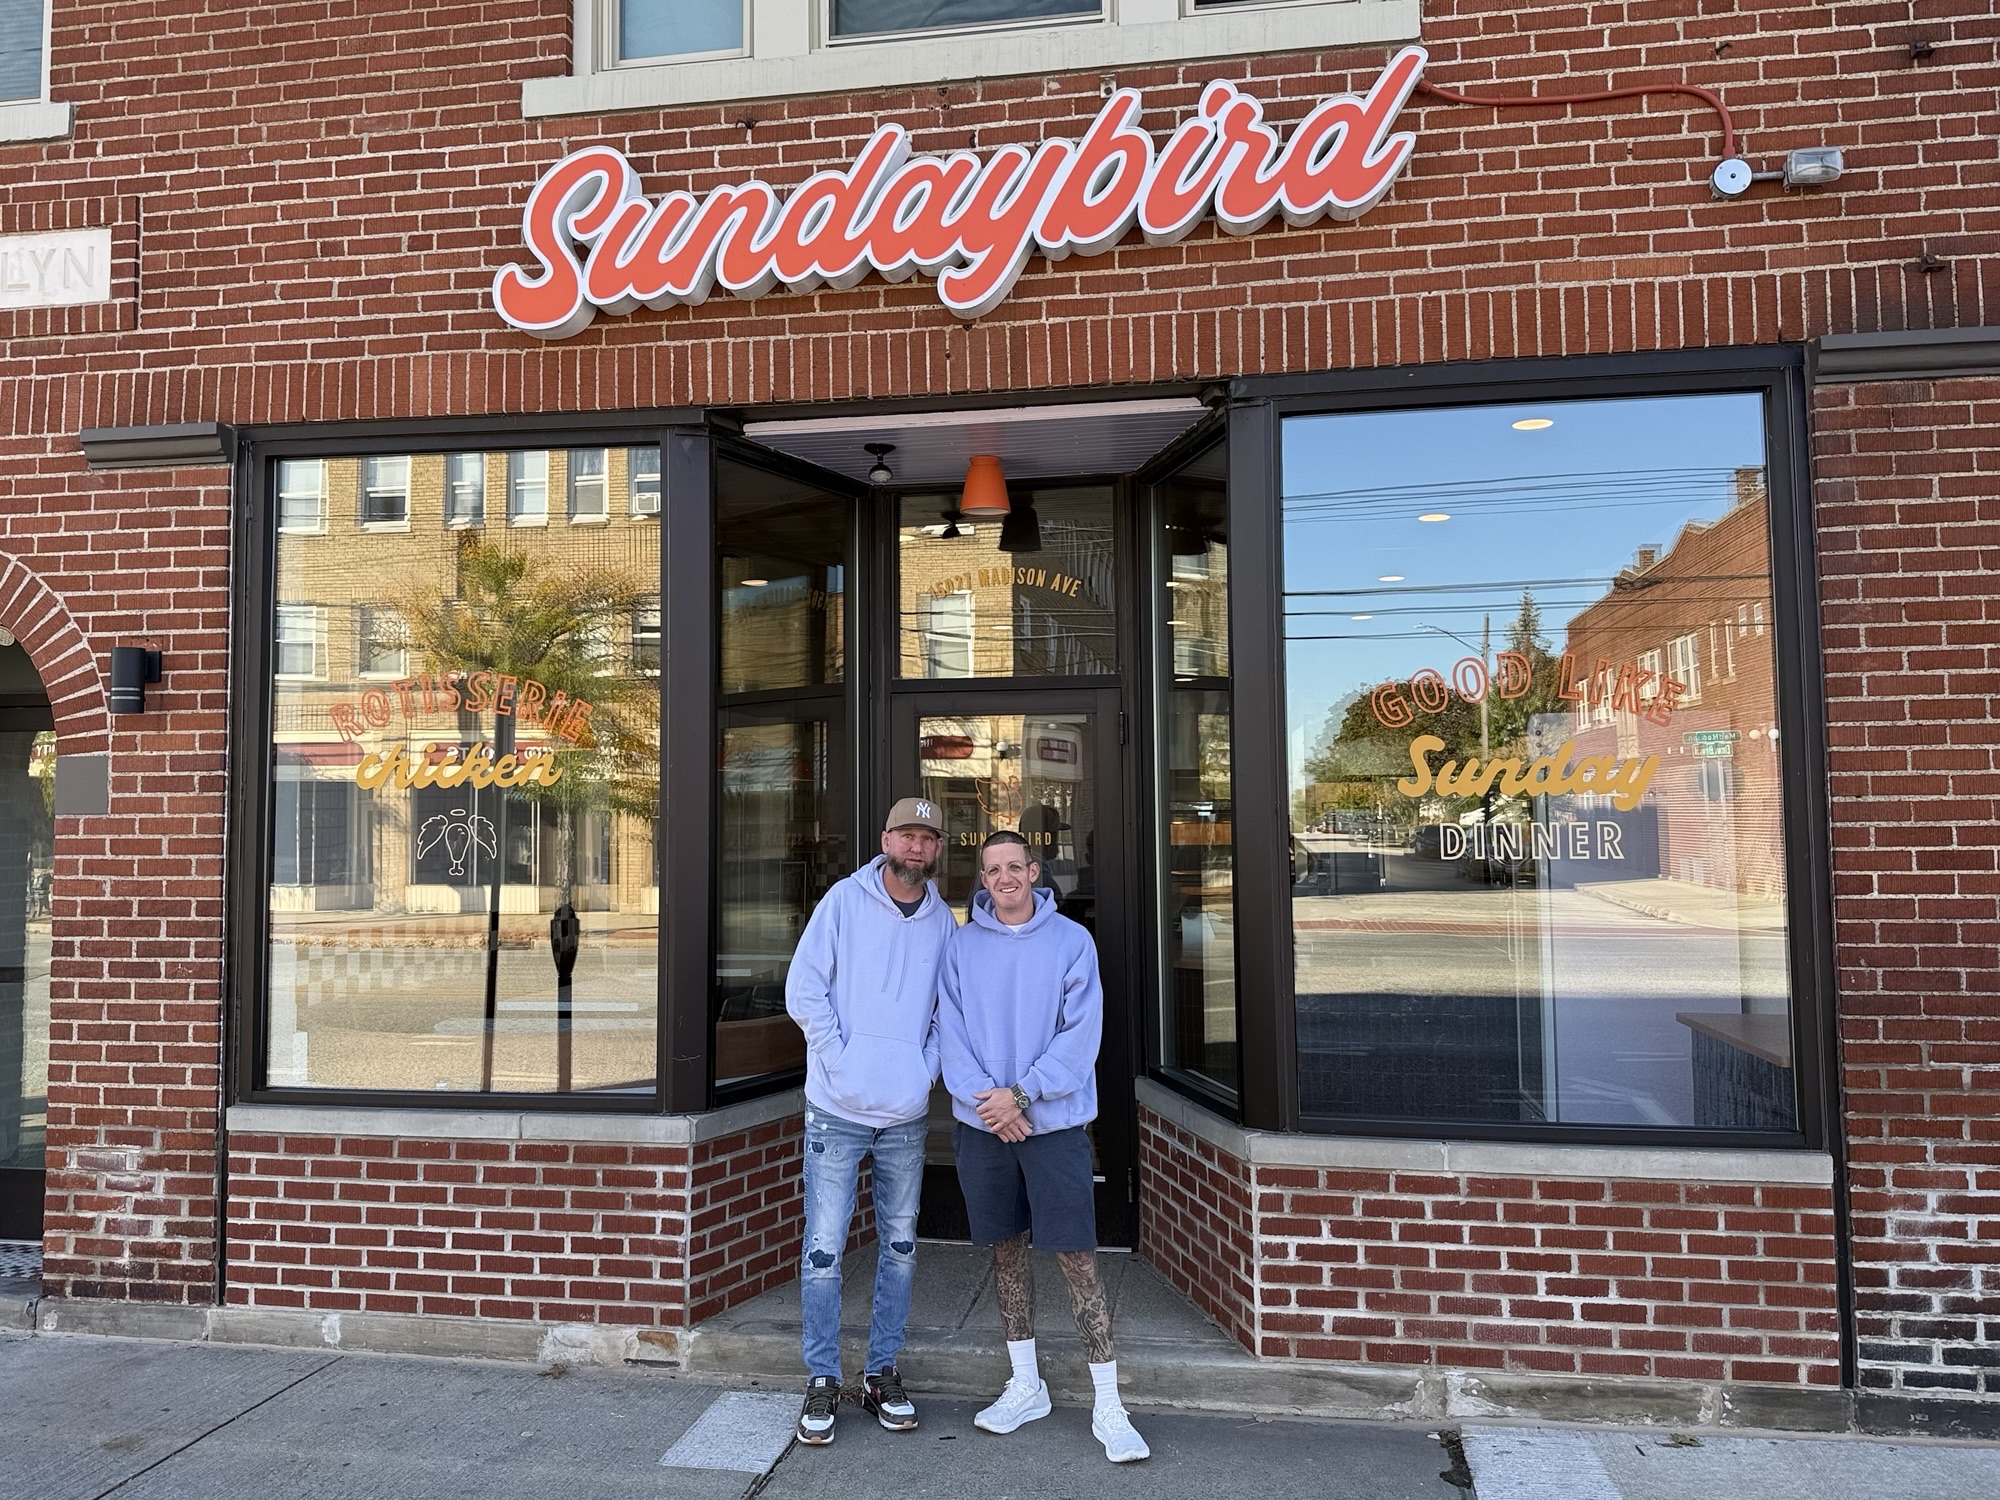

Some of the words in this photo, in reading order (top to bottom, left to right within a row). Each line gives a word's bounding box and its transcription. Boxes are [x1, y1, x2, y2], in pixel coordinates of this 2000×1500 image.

[493, 46, 1429, 334] Sundaybird
[977, 566, 1047, 588] MADISON
[1050, 573, 1082, 598] AVE
[328, 670, 594, 744] ROTISSERIE
[1371, 652, 1532, 729] GOOD
[1558, 653, 1687, 728] LIKE
[356, 742, 563, 790] chicken
[1397, 735, 1661, 812] Sunday
[915, 801, 932, 819] NY
[1440, 821, 1625, 860] DINNER
